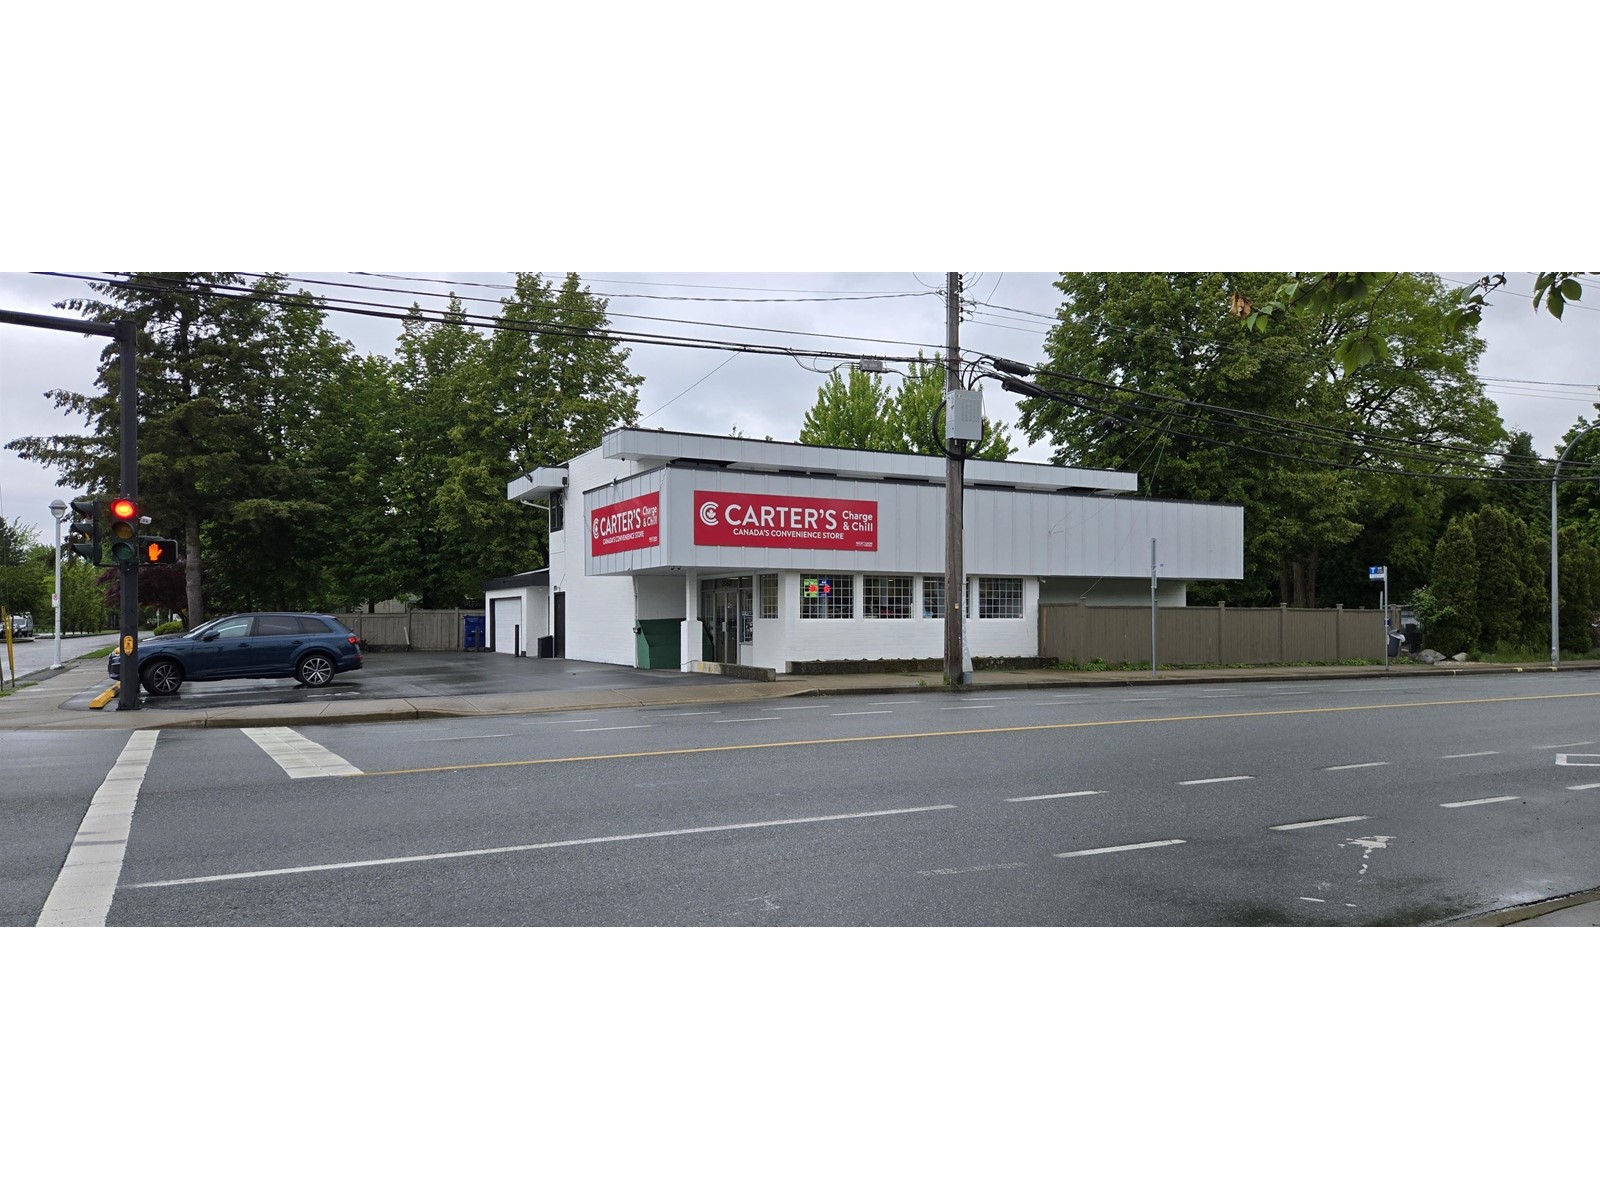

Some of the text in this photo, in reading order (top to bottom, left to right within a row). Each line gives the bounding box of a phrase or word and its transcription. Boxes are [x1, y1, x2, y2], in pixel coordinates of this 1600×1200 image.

[642, 506, 657, 516] Charge
[724, 503, 837, 530] CARTER'S
[842, 510, 873, 522] Charge
[600, 508, 641, 536] CARTER'S
[843, 521, 873, 531] & Chill
[733, 528, 770, 536] CANADA'S
[771, 530, 821, 539] CONVENIENCE
